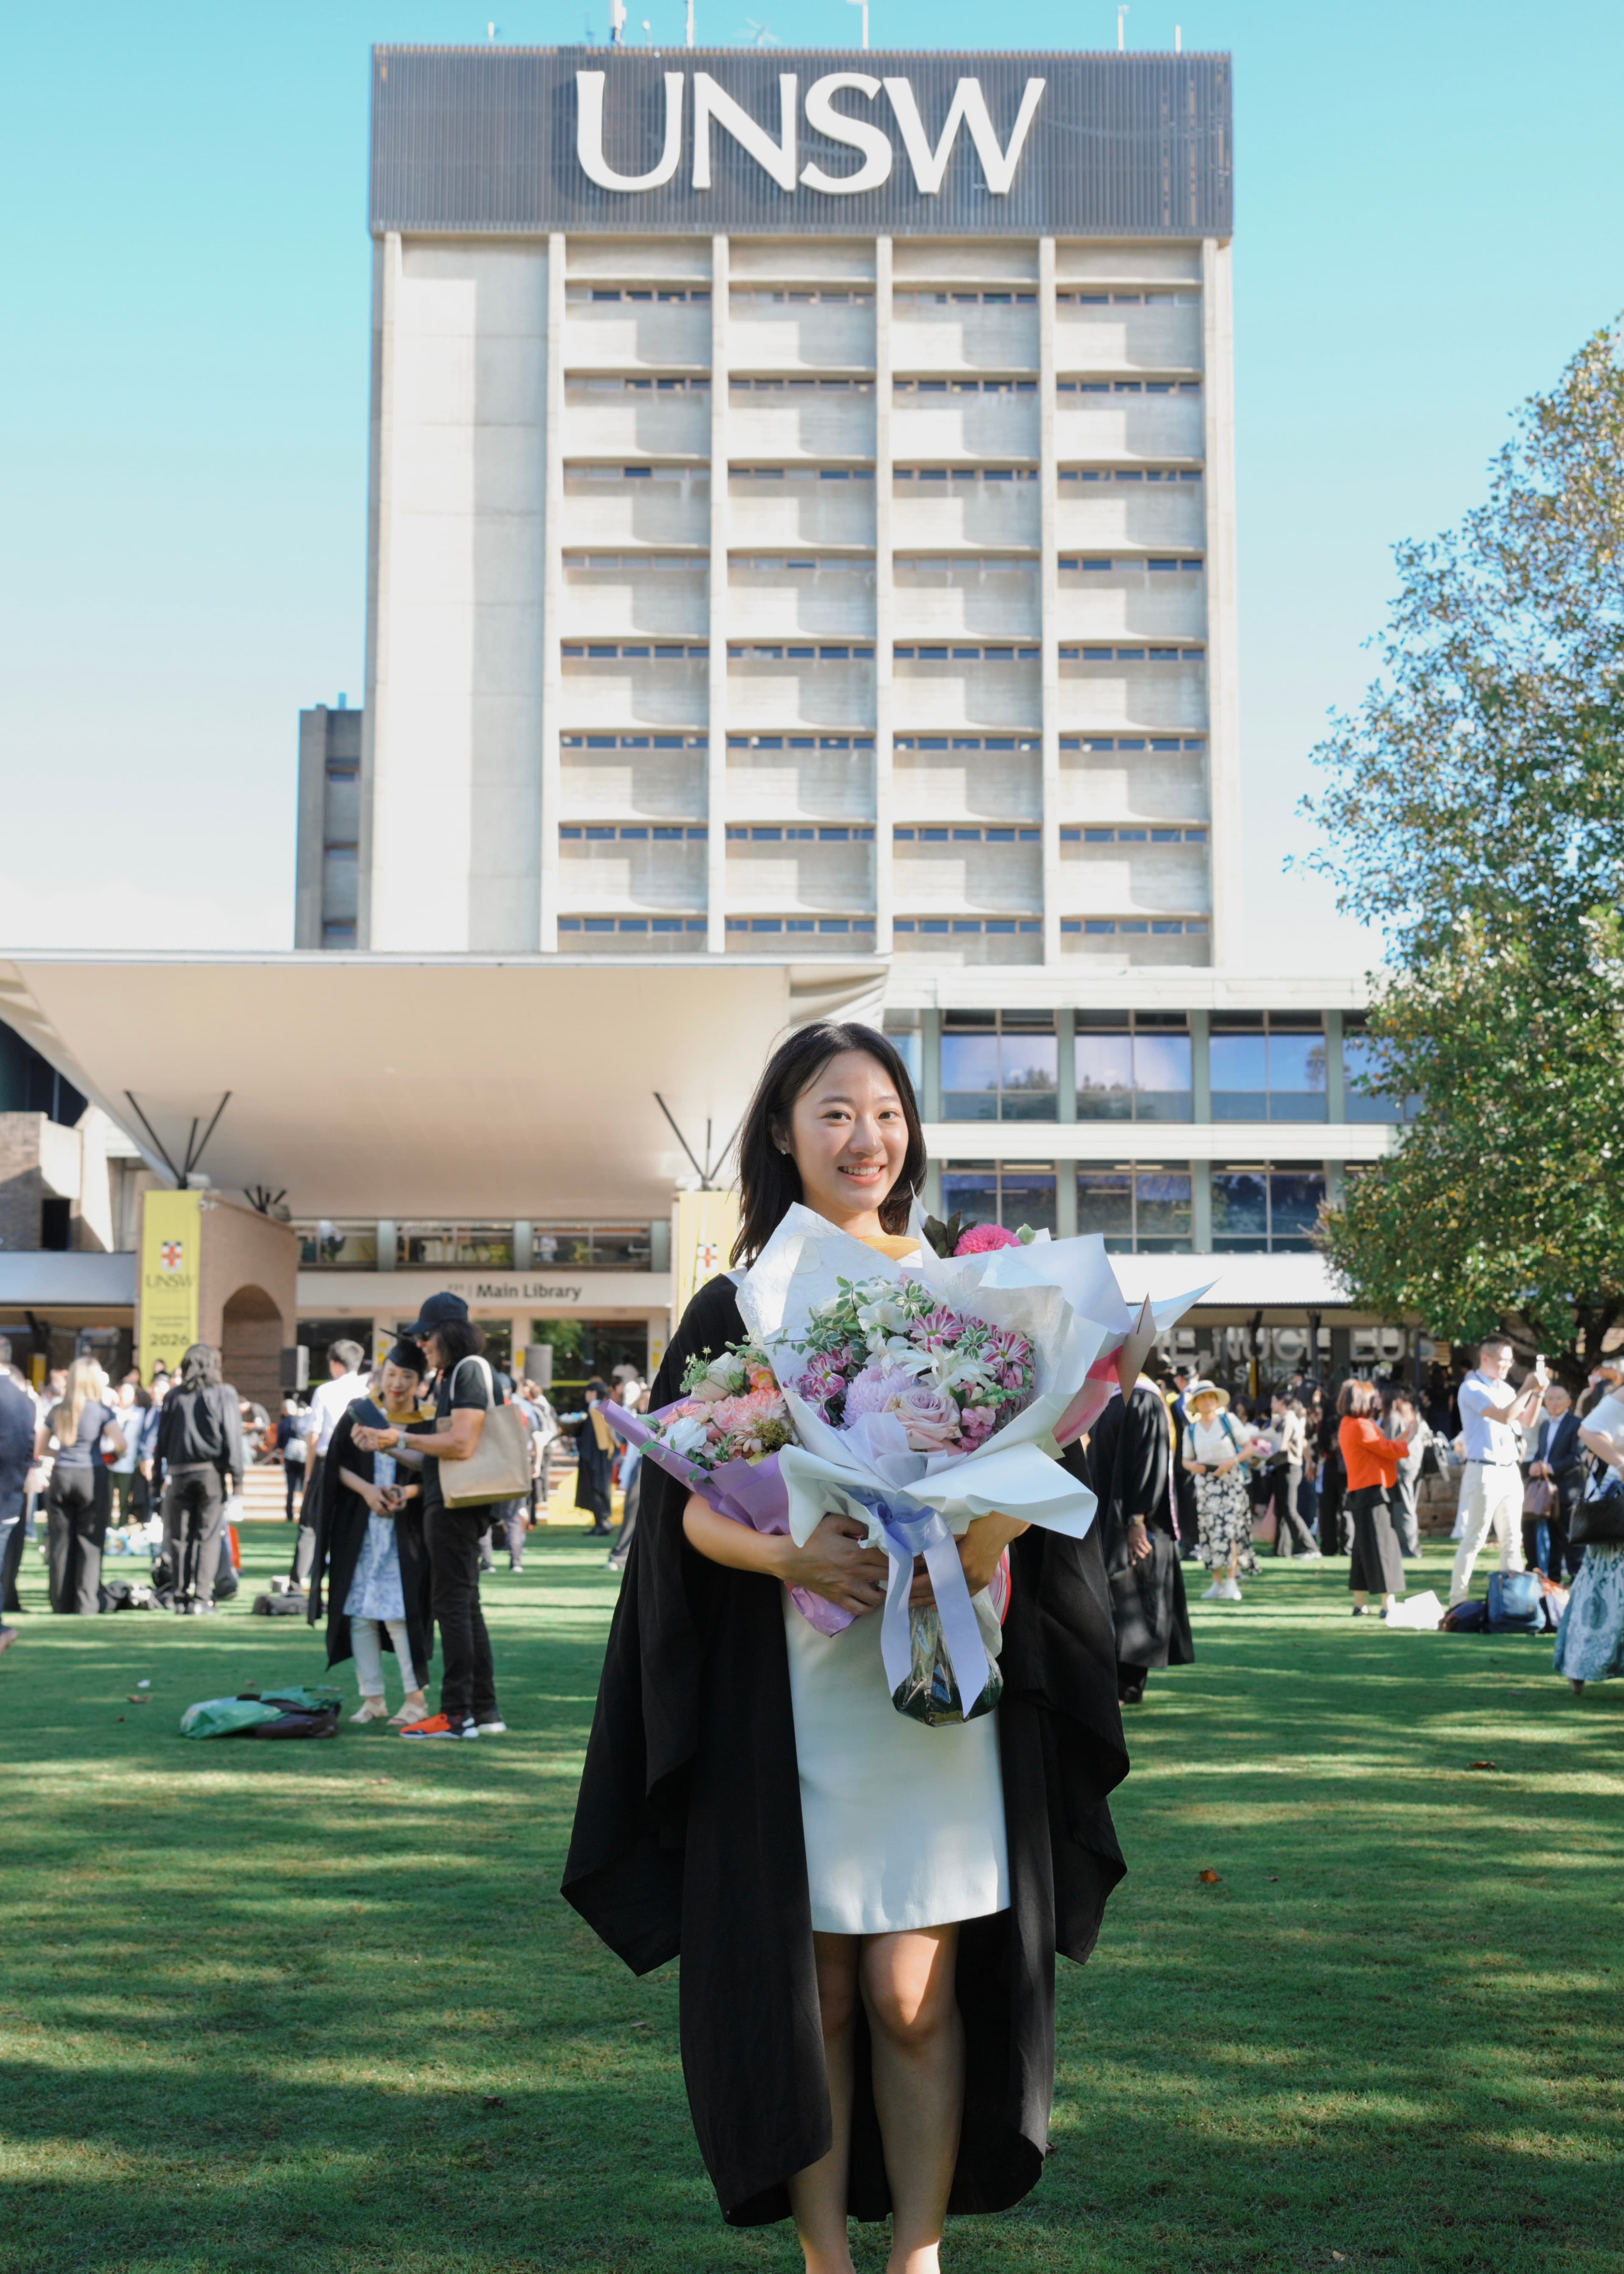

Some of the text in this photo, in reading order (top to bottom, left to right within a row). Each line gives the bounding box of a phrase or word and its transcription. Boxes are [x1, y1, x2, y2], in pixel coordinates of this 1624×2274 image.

[576, 71, 1046, 194] UNSW
[146, 1274, 195, 1288] UNSW
[476, 1283, 519, 1298] Main
[523, 1282, 582, 1302] Library
[149, 1333, 190, 1347] 2026
